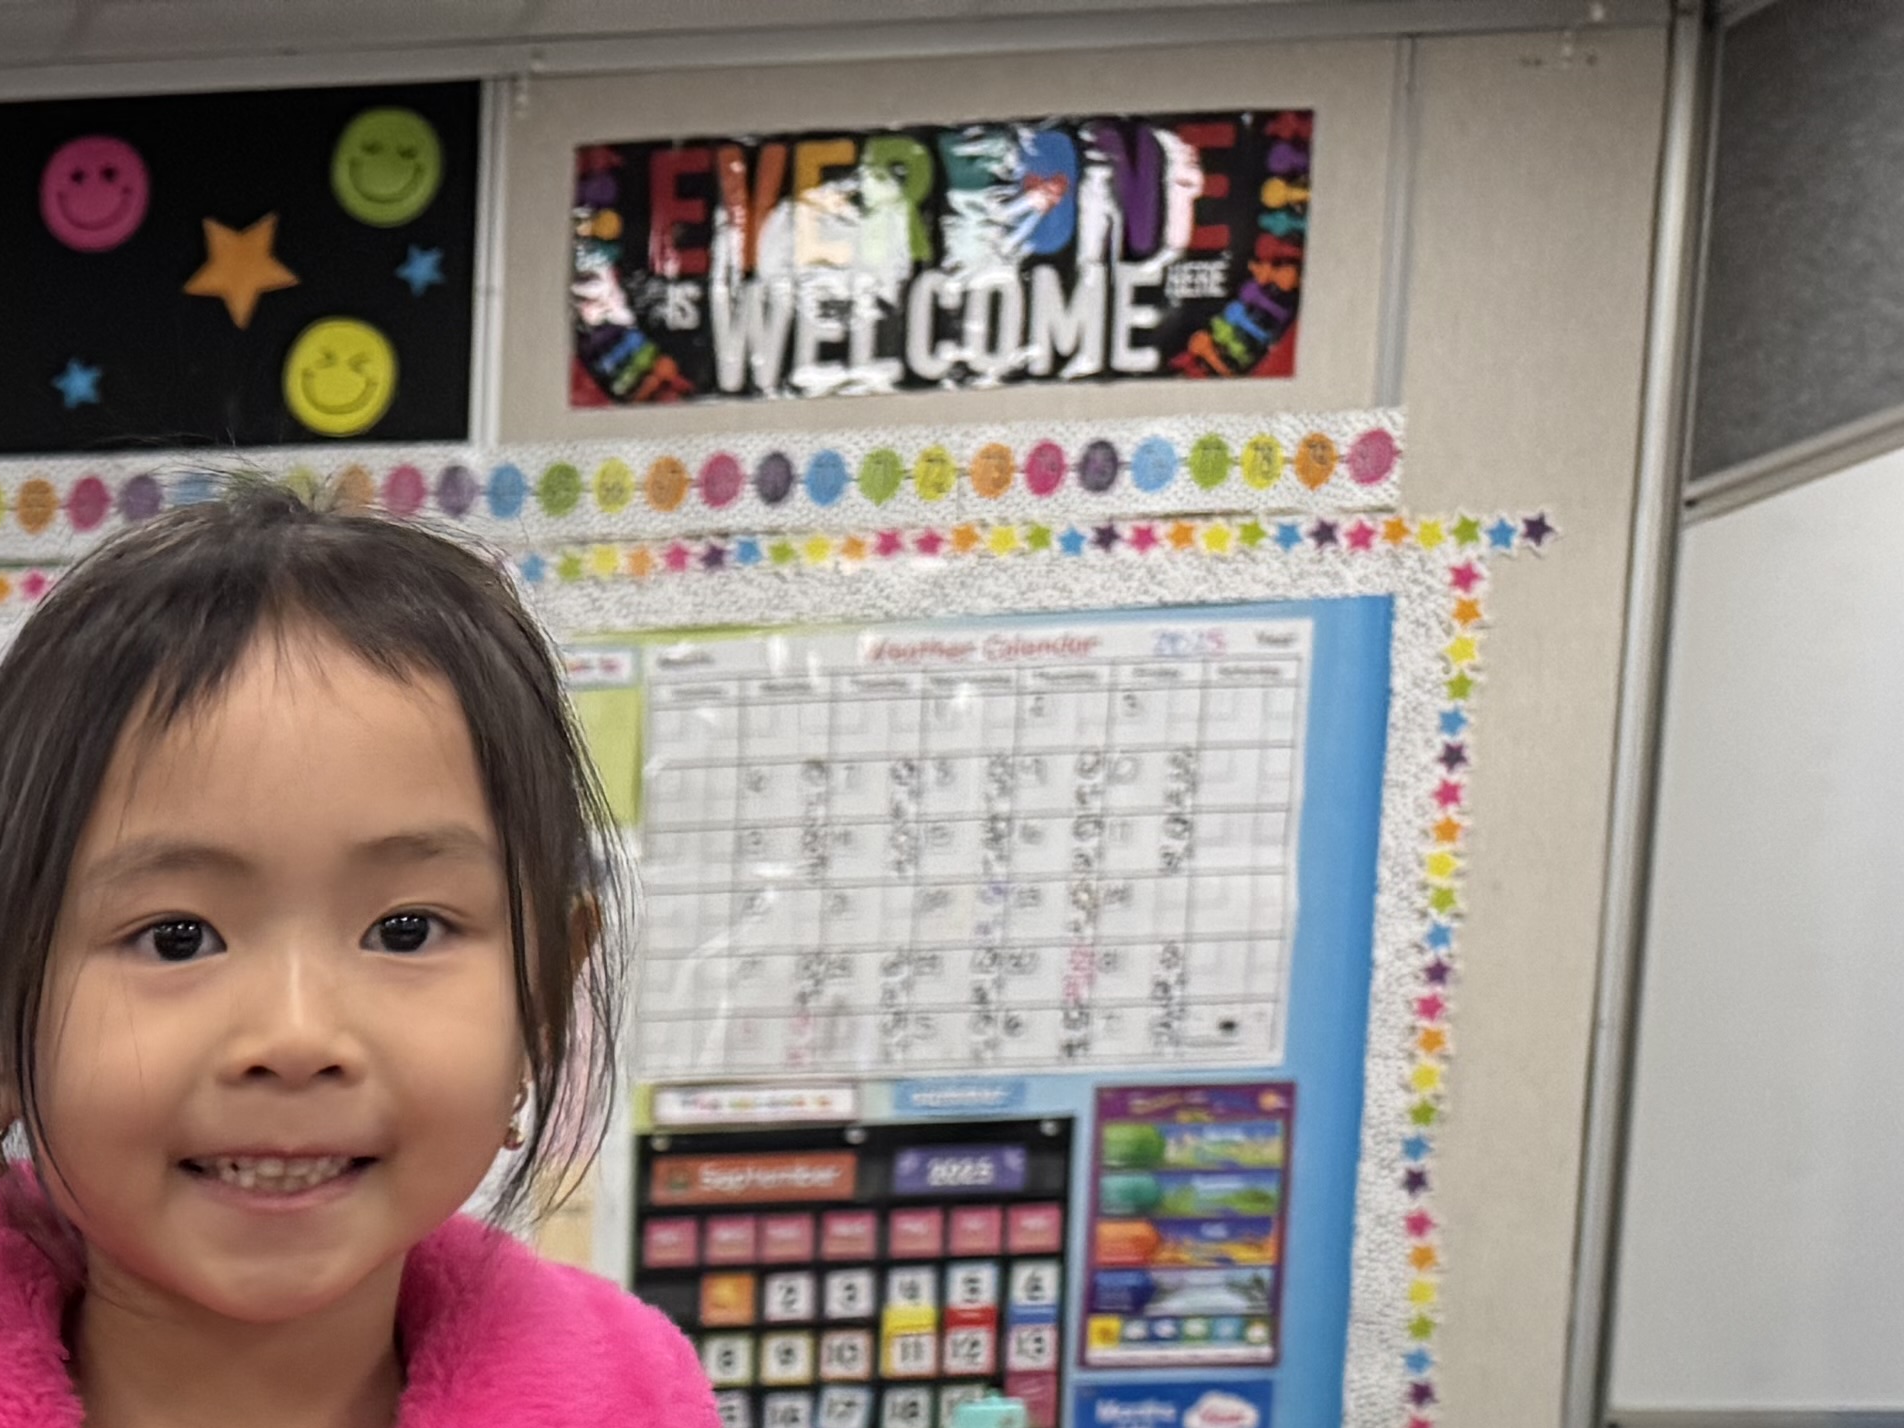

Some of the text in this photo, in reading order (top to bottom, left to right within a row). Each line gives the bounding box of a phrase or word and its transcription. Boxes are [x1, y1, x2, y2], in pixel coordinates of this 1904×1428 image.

[649, 122, 1235, 278] EVERYONE
[711, 262, 1162, 394] WELCOME
[695, 1163, 843, 1191] September
